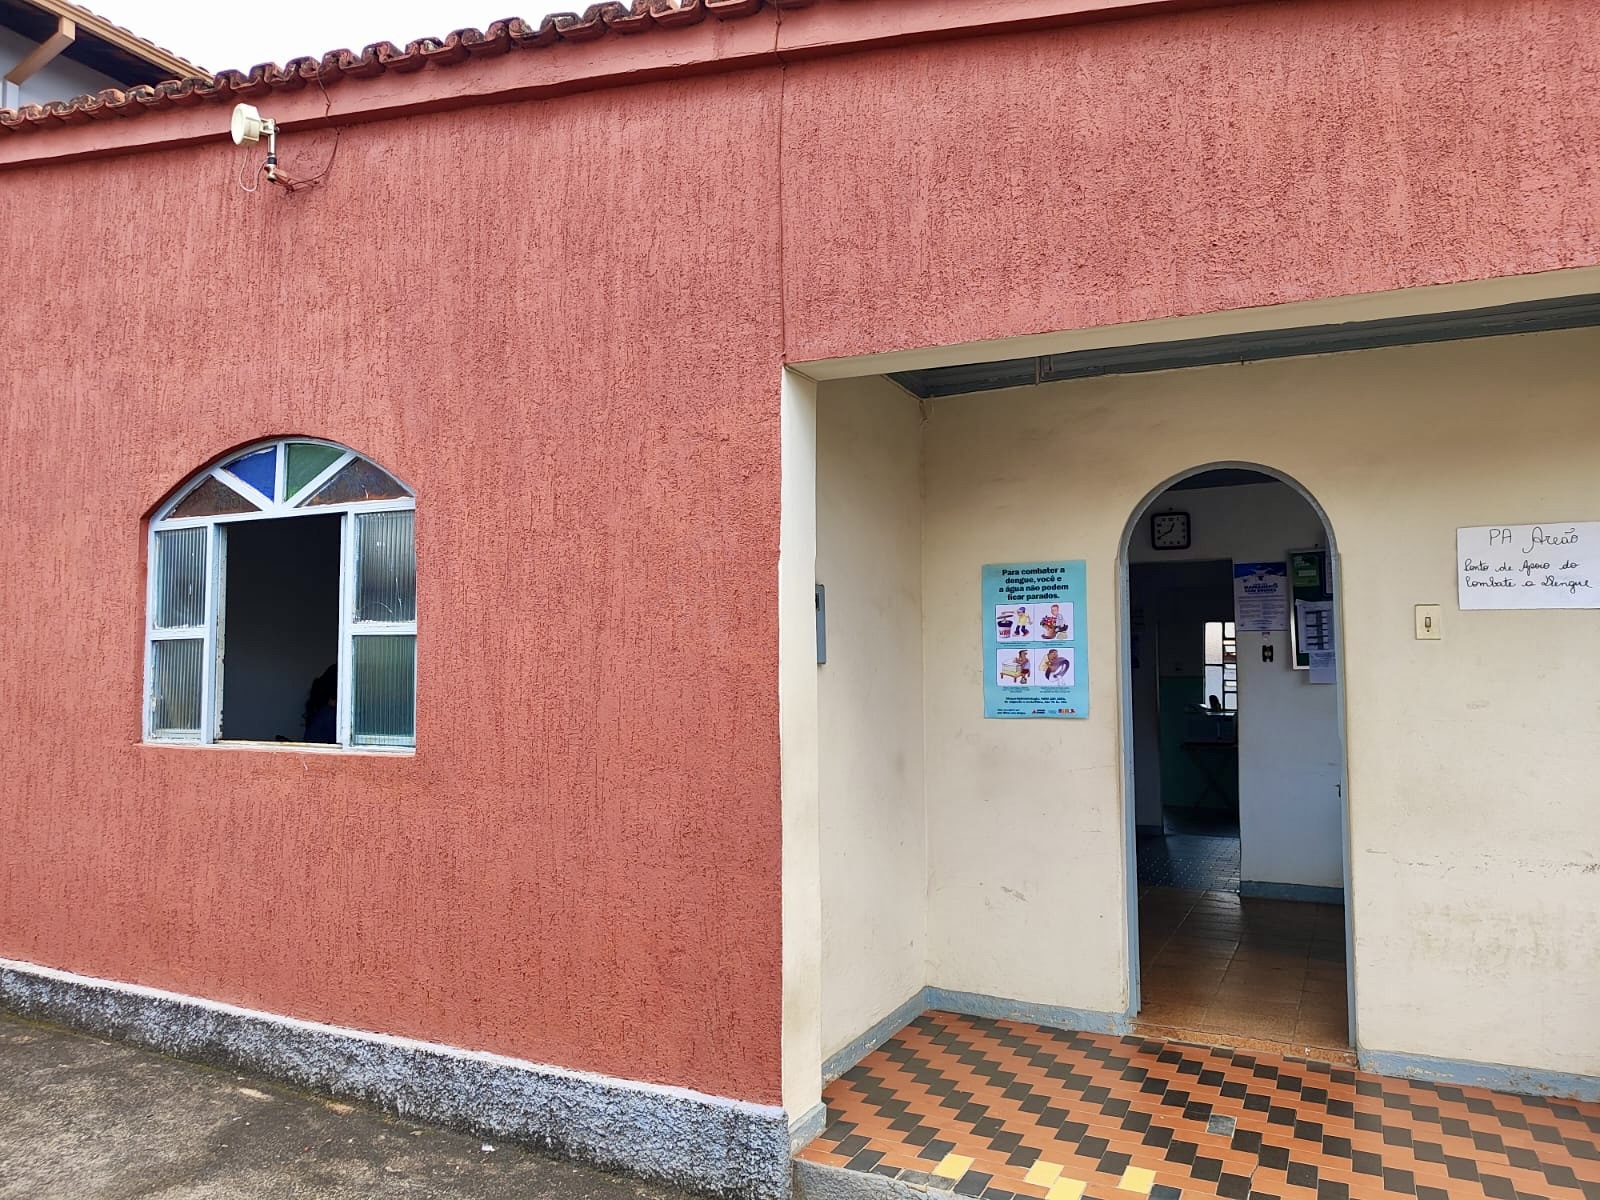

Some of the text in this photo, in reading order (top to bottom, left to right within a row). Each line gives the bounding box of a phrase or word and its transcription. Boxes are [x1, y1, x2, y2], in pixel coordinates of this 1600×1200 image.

[1489, 526, 1579, 554] PA Areão
[1464, 558, 1490, 572] Ponto
[1495, 562, 1514, 572] de
[1518, 560, 1550, 576] Apoio
[1006, 585, 1024, 593] água
[1465, 576, 1516, 588] Combate
[1541, 575, 1592, 594] Dengue
[1026, 593, 1060, 601] parados.
